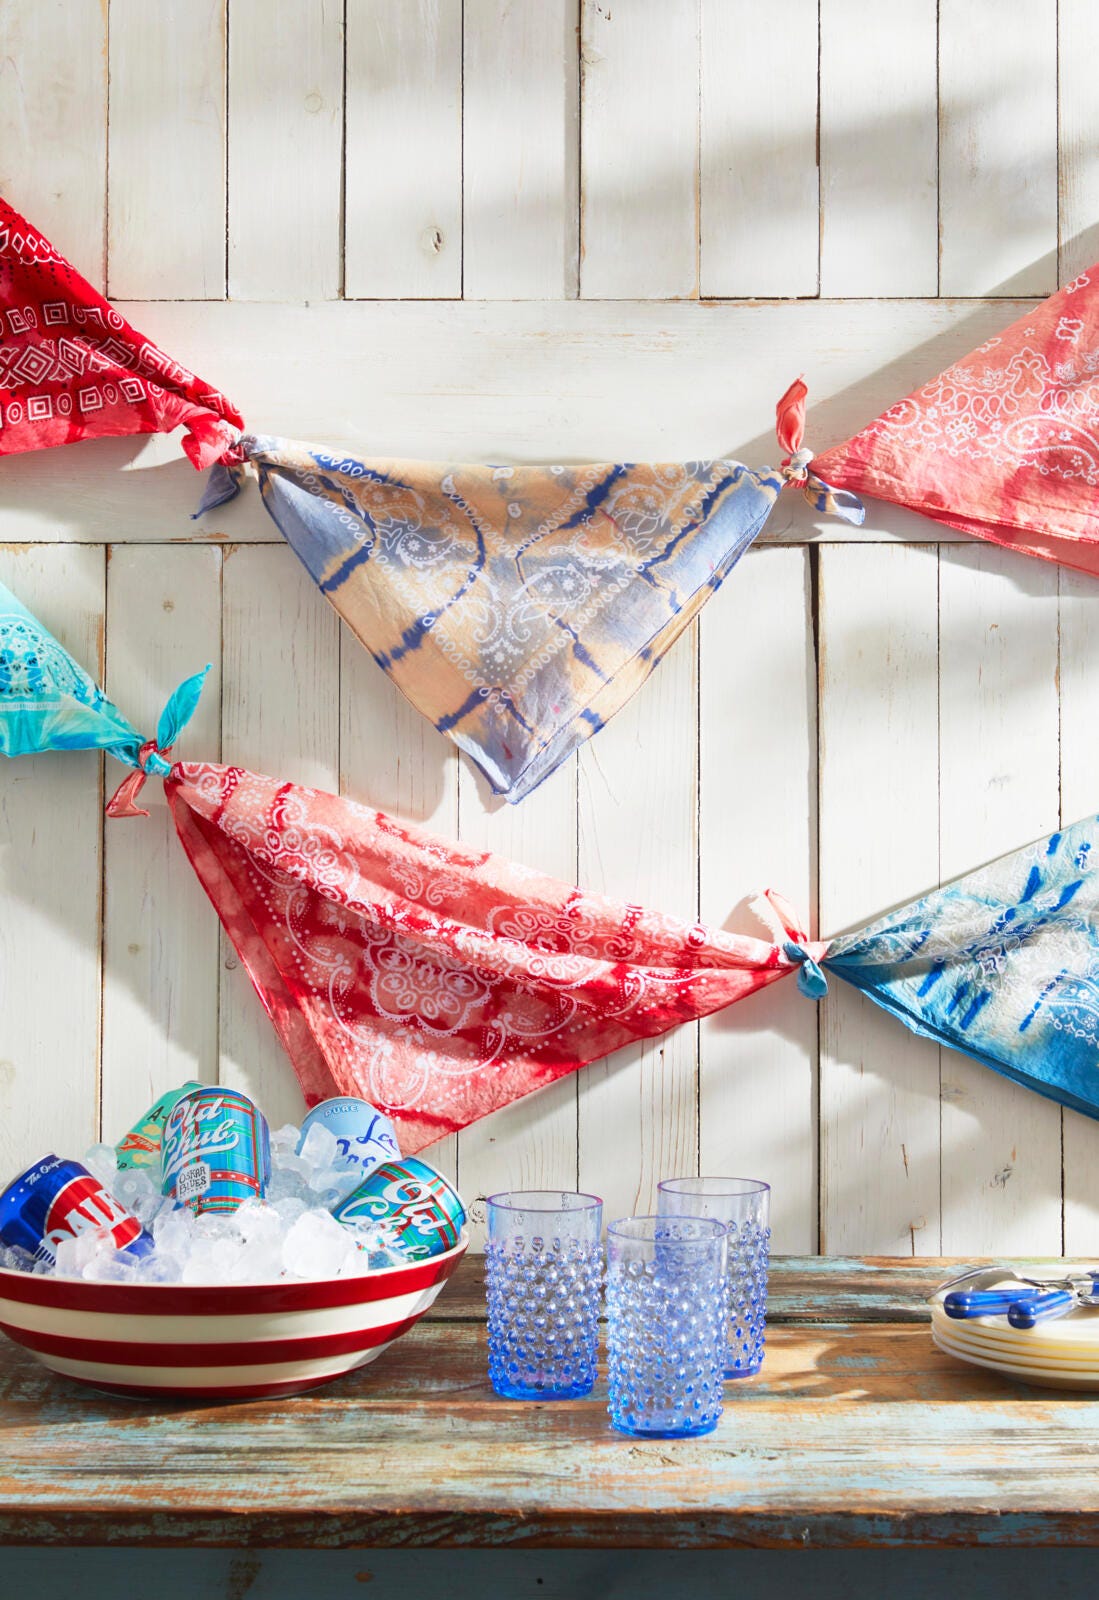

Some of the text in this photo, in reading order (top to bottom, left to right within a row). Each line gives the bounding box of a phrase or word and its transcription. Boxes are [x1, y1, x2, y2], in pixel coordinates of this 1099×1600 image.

[164, 1097, 224, 1142] Old
[323, 1104, 359, 1118] PURE
[356, 1114, 398, 1155] La
[162, 1119, 239, 1184] Chub
[24, 1172, 41, 1185] The
[178, 1165, 206, 1184] OSKAR
[179, 1175, 207, 1196] BLUES
[382, 1178, 449, 1236] Old
